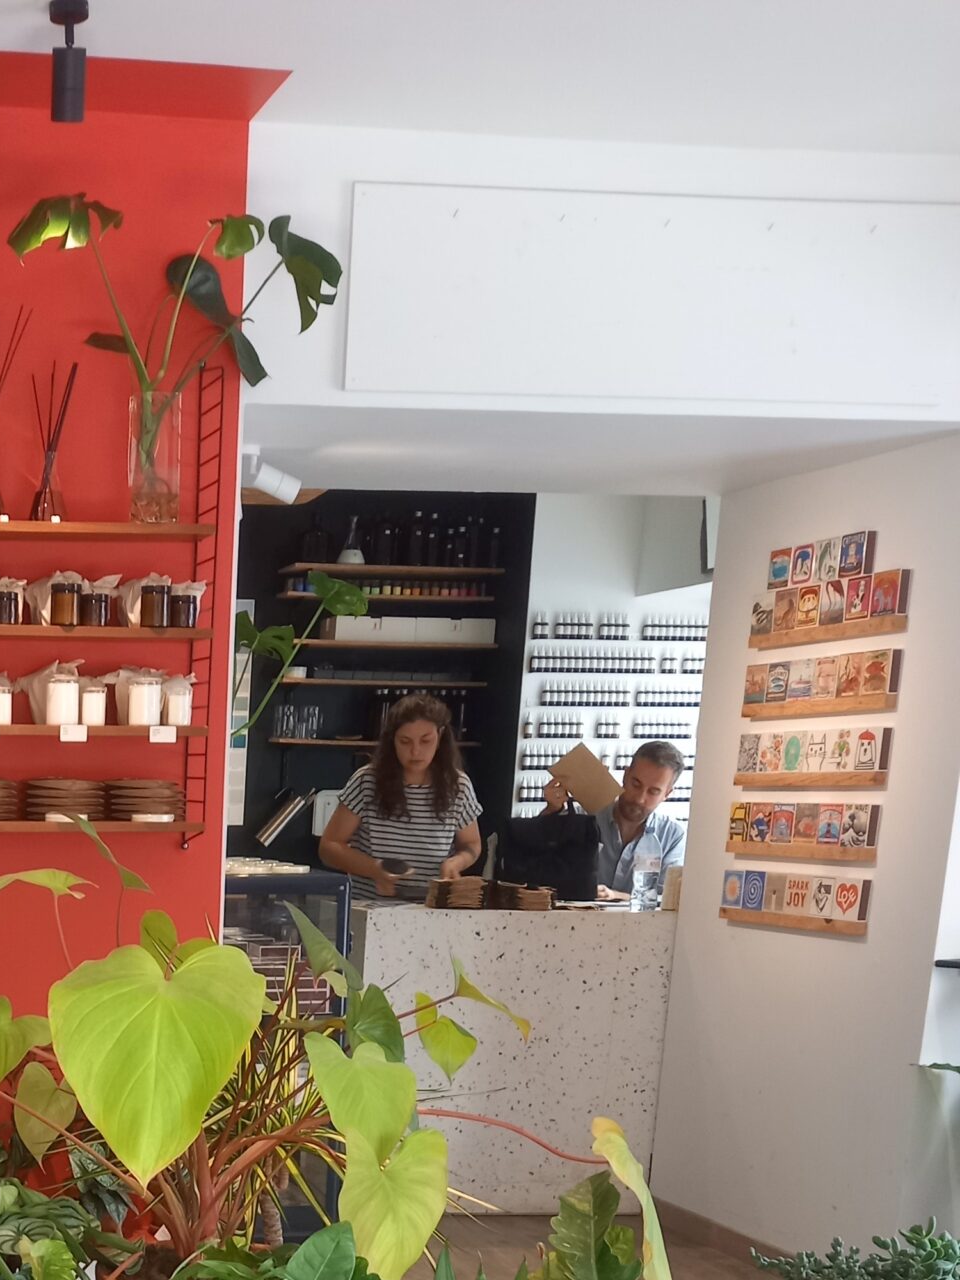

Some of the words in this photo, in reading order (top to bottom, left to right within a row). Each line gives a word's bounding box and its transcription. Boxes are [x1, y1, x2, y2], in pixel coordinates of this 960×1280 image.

[788, 879, 809, 890] SPARK
[786, 891, 807, 907] JOY
[837, 888, 857, 910] LOVE
